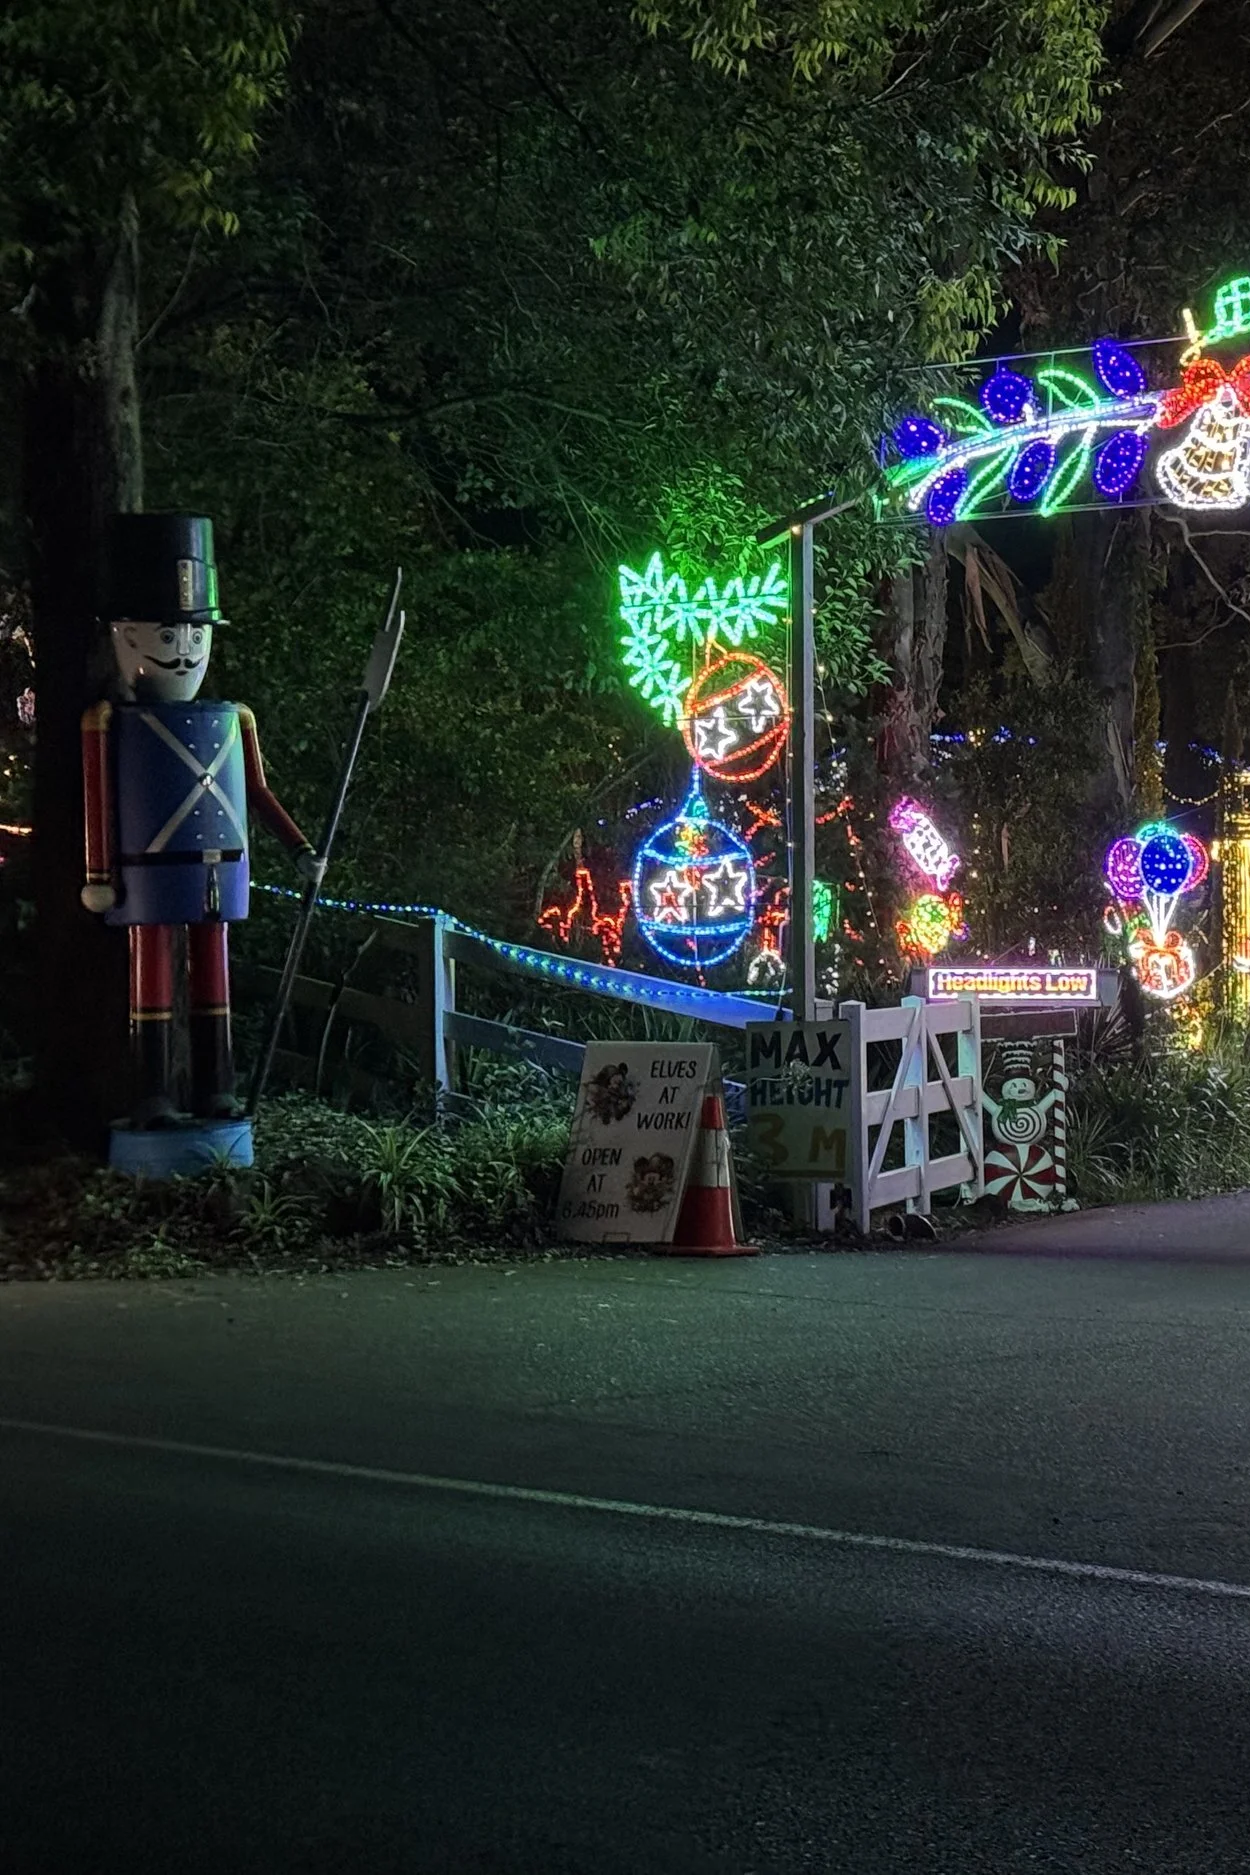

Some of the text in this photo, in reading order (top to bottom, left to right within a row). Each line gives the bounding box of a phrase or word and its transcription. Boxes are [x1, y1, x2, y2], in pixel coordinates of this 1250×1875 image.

[936, 973, 1089, 992] Headlights Low
[751, 1030, 842, 1070] MAX
[650, 1060, 697, 1079] ELVES
[658, 1086, 680, 1105] AT
[750, 1076, 850, 1109] HEIGHT
[636, 1111, 692, 1131] WORK!
[752, 1112, 847, 1167] 3 M
[581, 1147, 622, 1166] OPEN
[587, 1174, 608, 1192] AT
